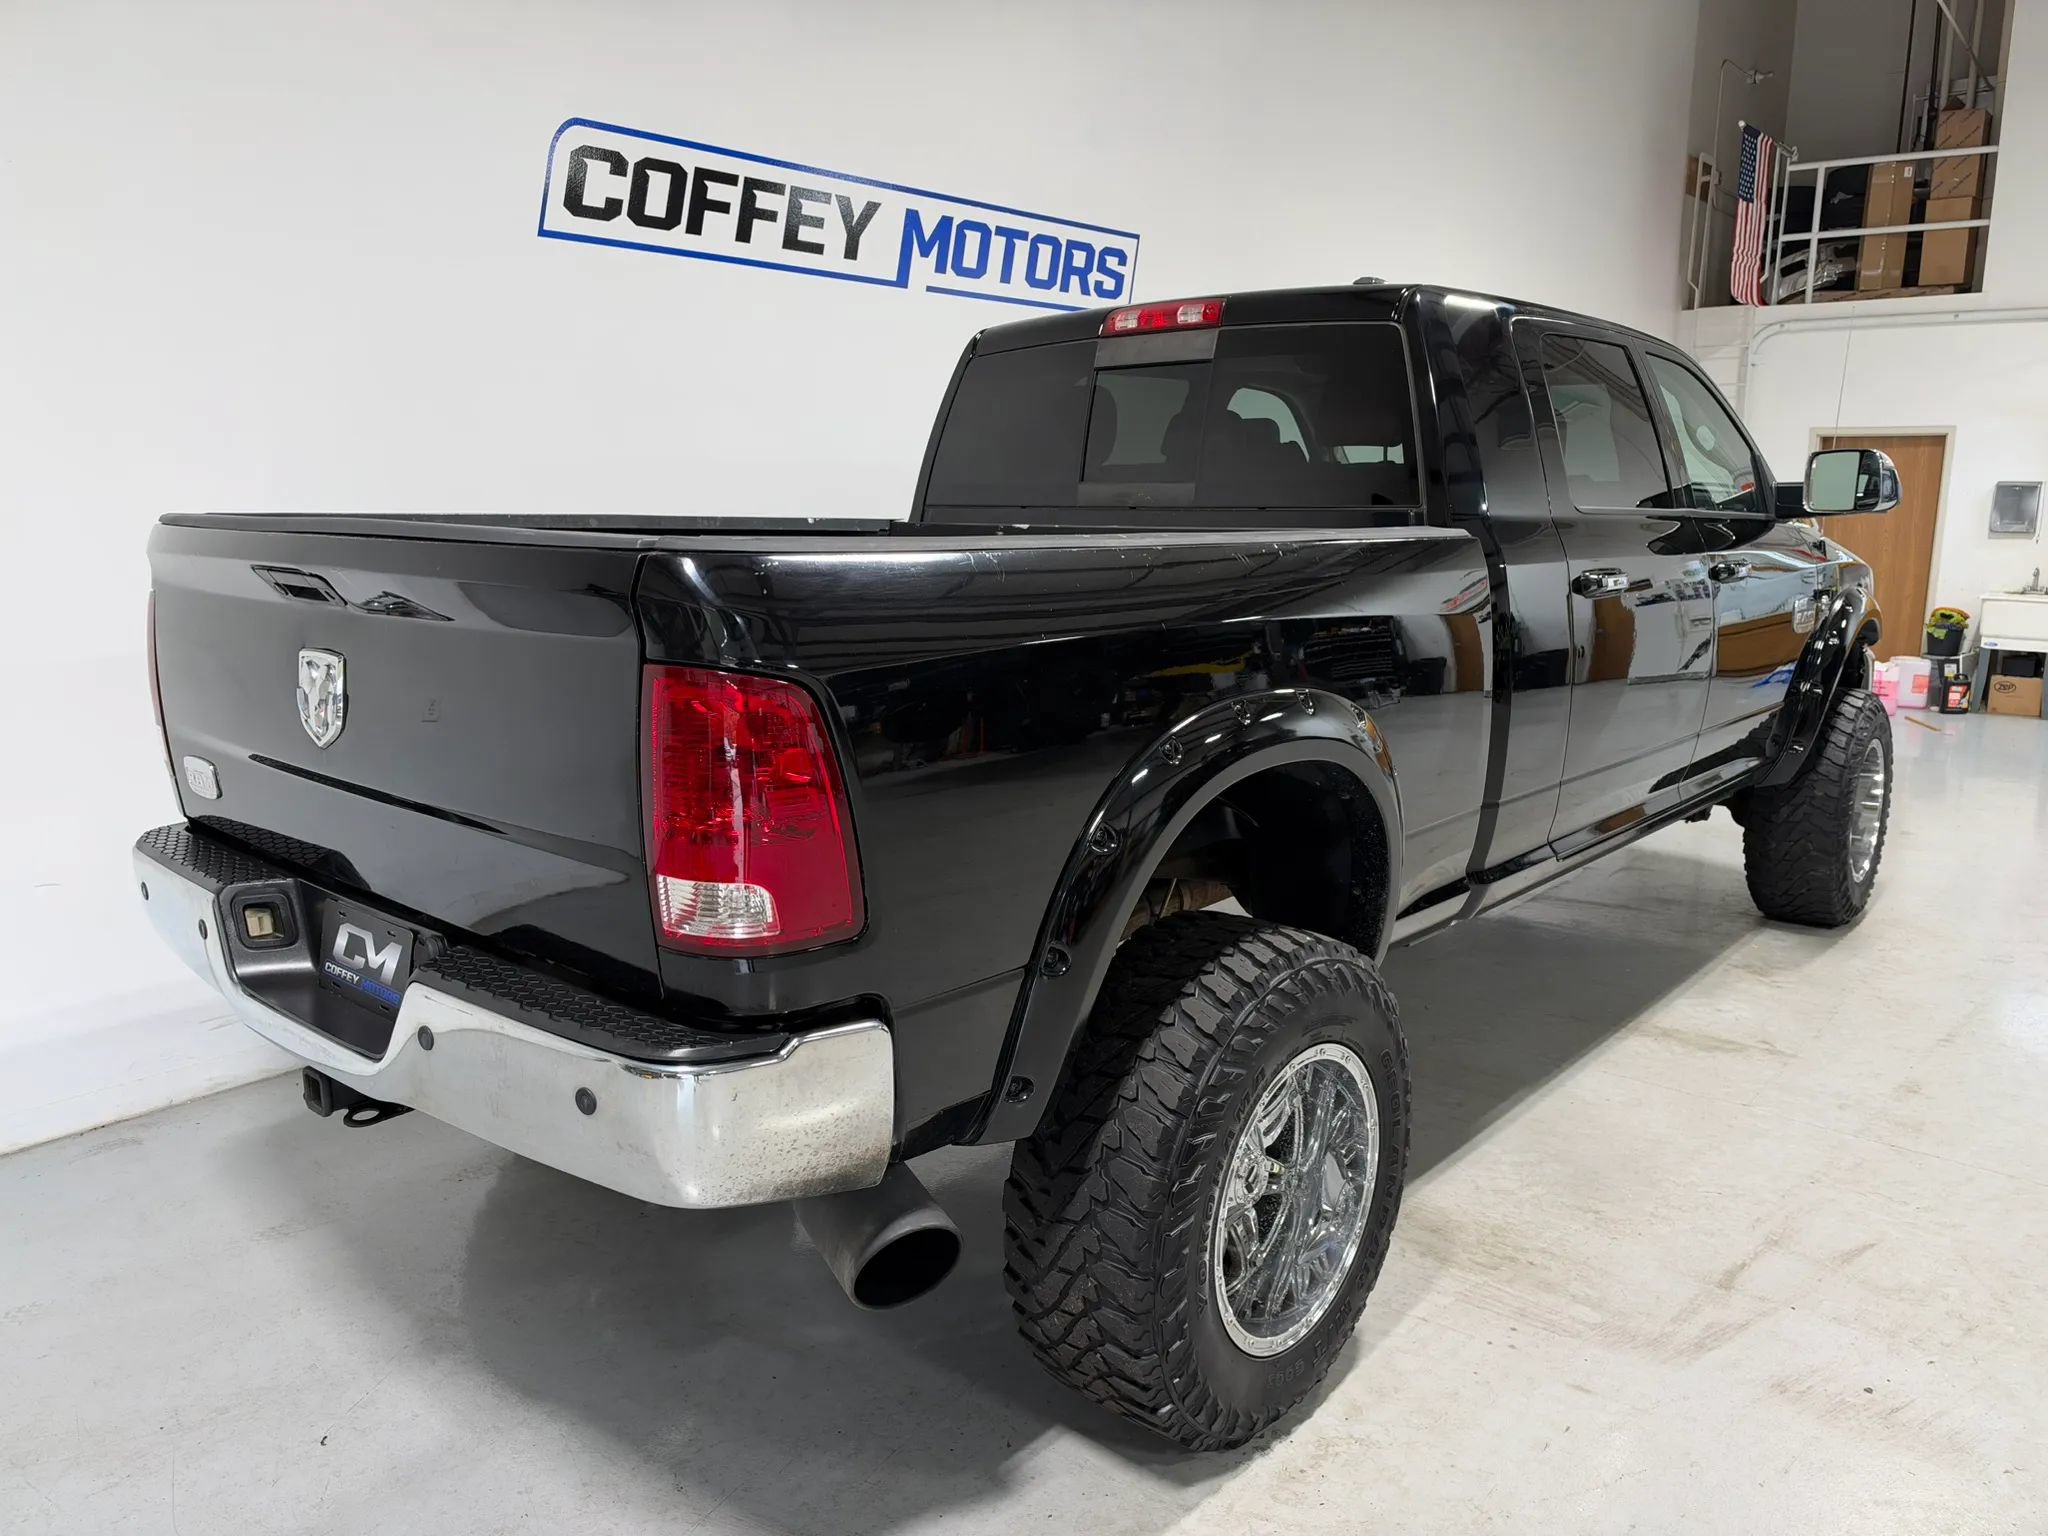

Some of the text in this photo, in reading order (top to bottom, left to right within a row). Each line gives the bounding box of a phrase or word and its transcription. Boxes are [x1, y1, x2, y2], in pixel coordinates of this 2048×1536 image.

[562, 144, 1128, 300] COFFEY MOTORS
[324, 961, 360, 985] COFFEY
[332, 922, 403, 985] CM
